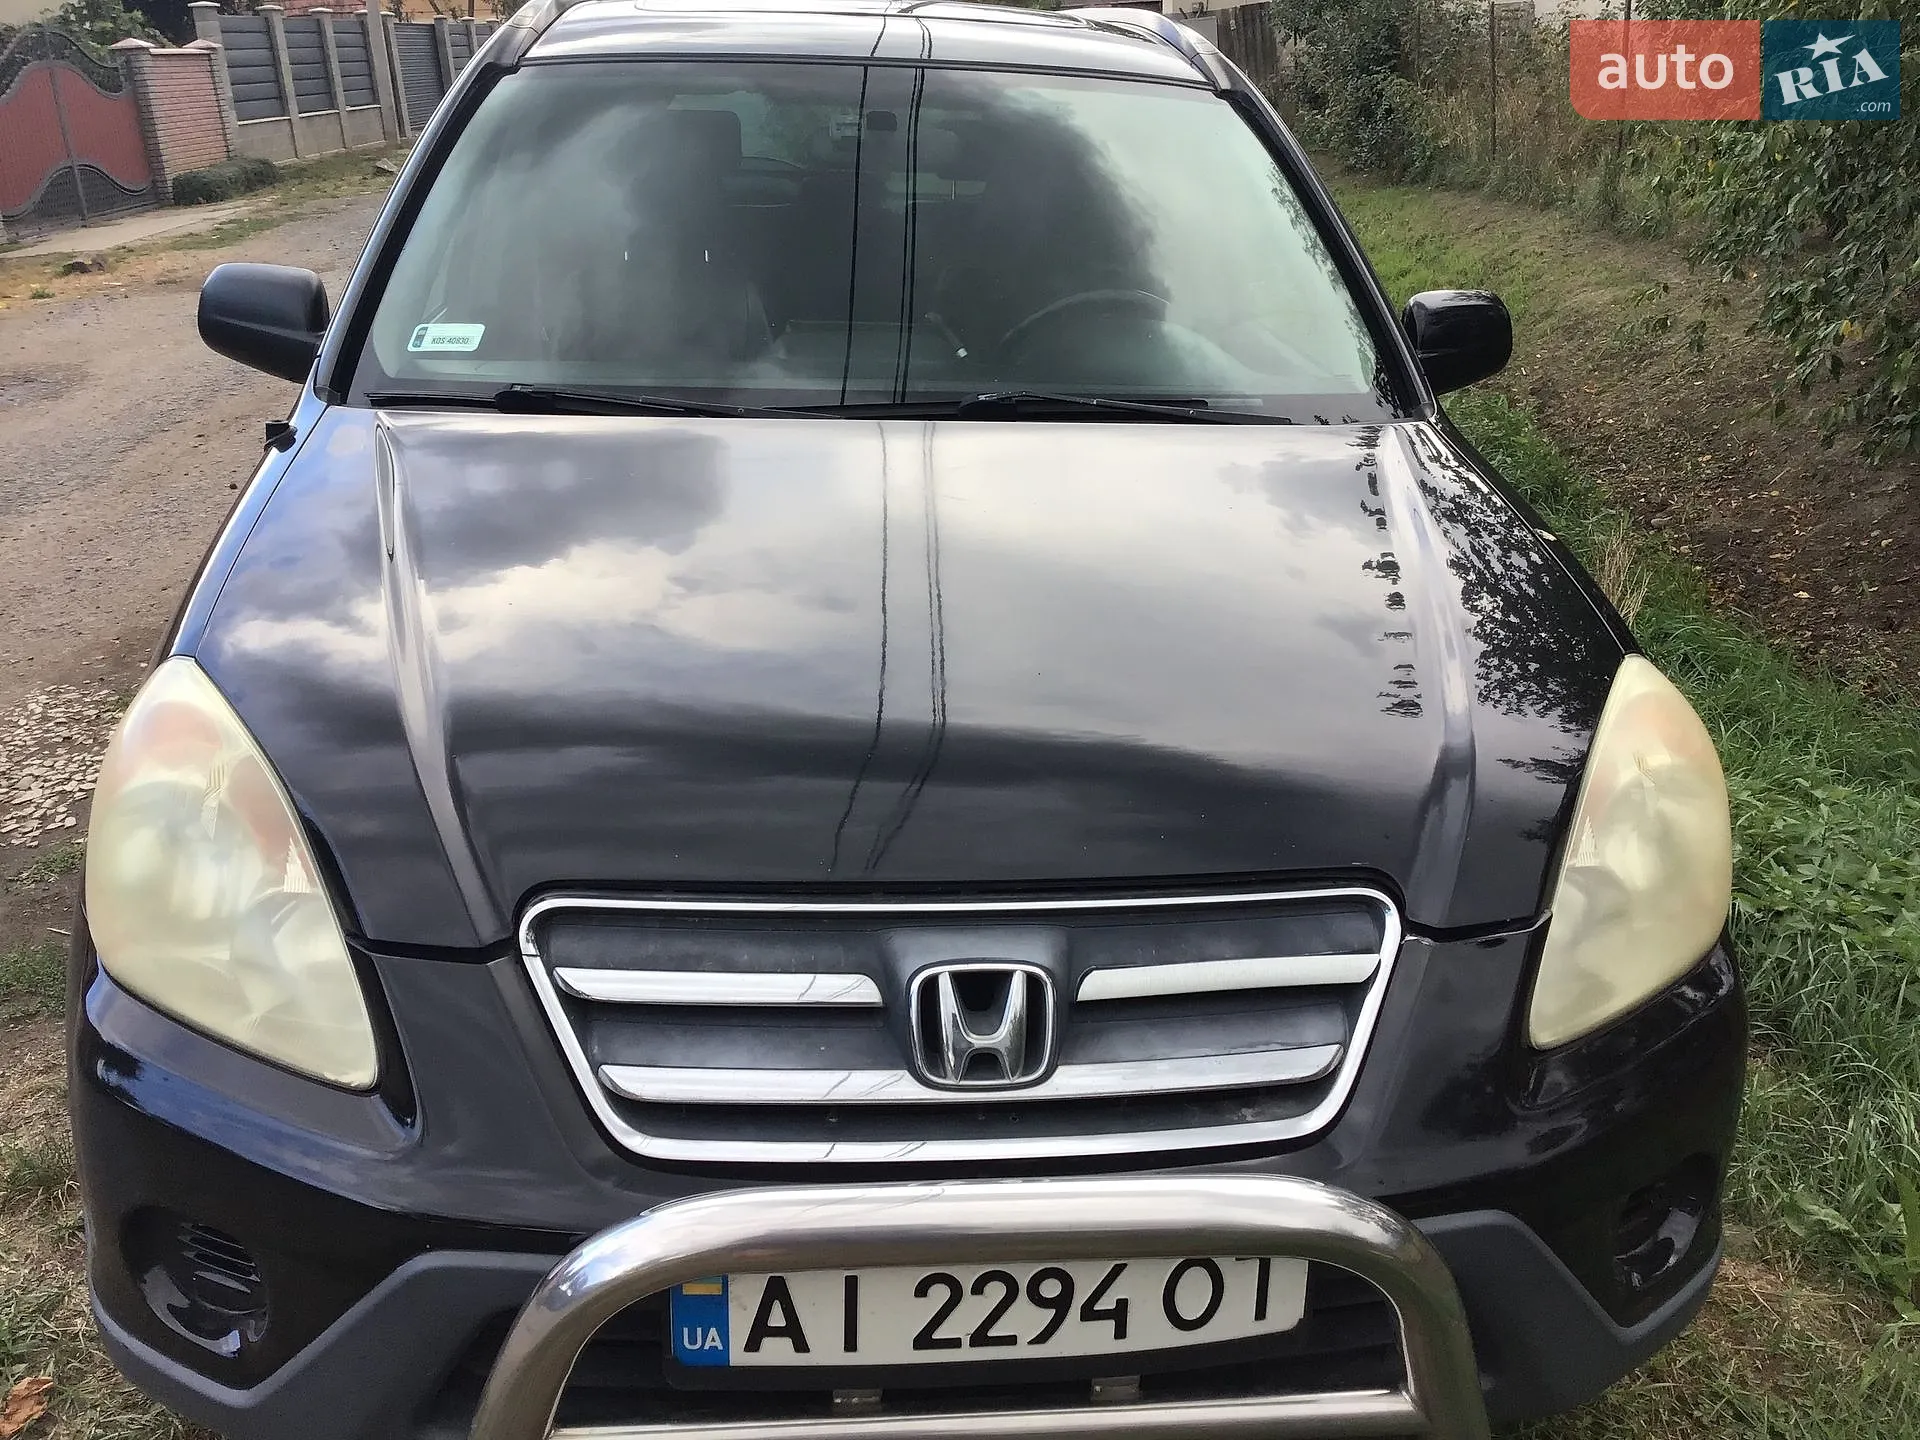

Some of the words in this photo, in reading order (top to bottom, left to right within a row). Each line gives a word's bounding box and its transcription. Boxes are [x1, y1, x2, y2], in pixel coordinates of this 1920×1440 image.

[743, 1275, 858, 1353] AI
[912, 1262, 1128, 1351] 2294
[682, 1327, 724, 1350] UA
